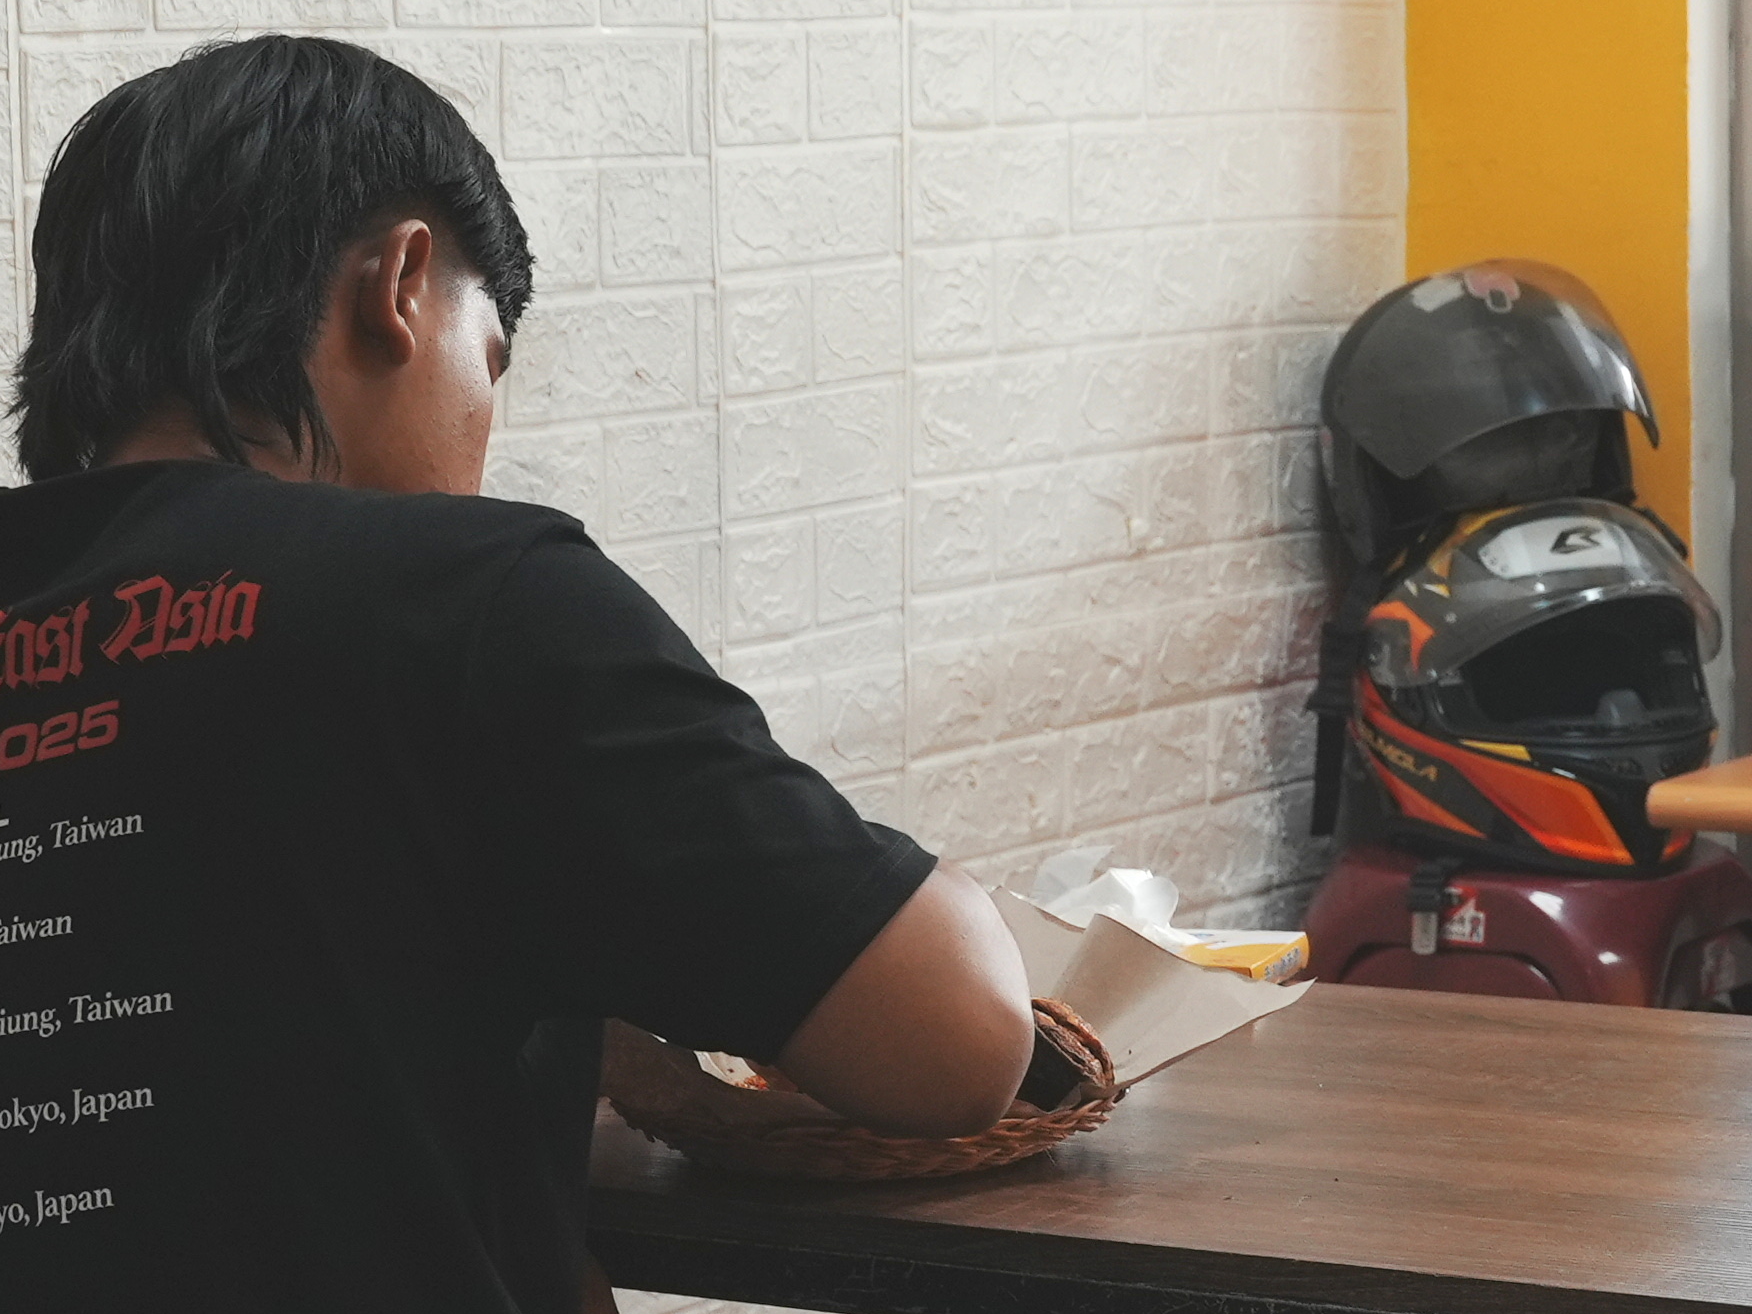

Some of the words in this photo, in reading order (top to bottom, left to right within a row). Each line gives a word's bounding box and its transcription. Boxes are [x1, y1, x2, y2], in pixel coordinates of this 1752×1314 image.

[100, 569, 263, 663] Asia
[49, 814, 144, 849] Taiwan
[68, 991, 174, 1024] Taiwan
[71, 1087, 155, 1126] Japan
[34, 1187, 115, 1227] Japan
